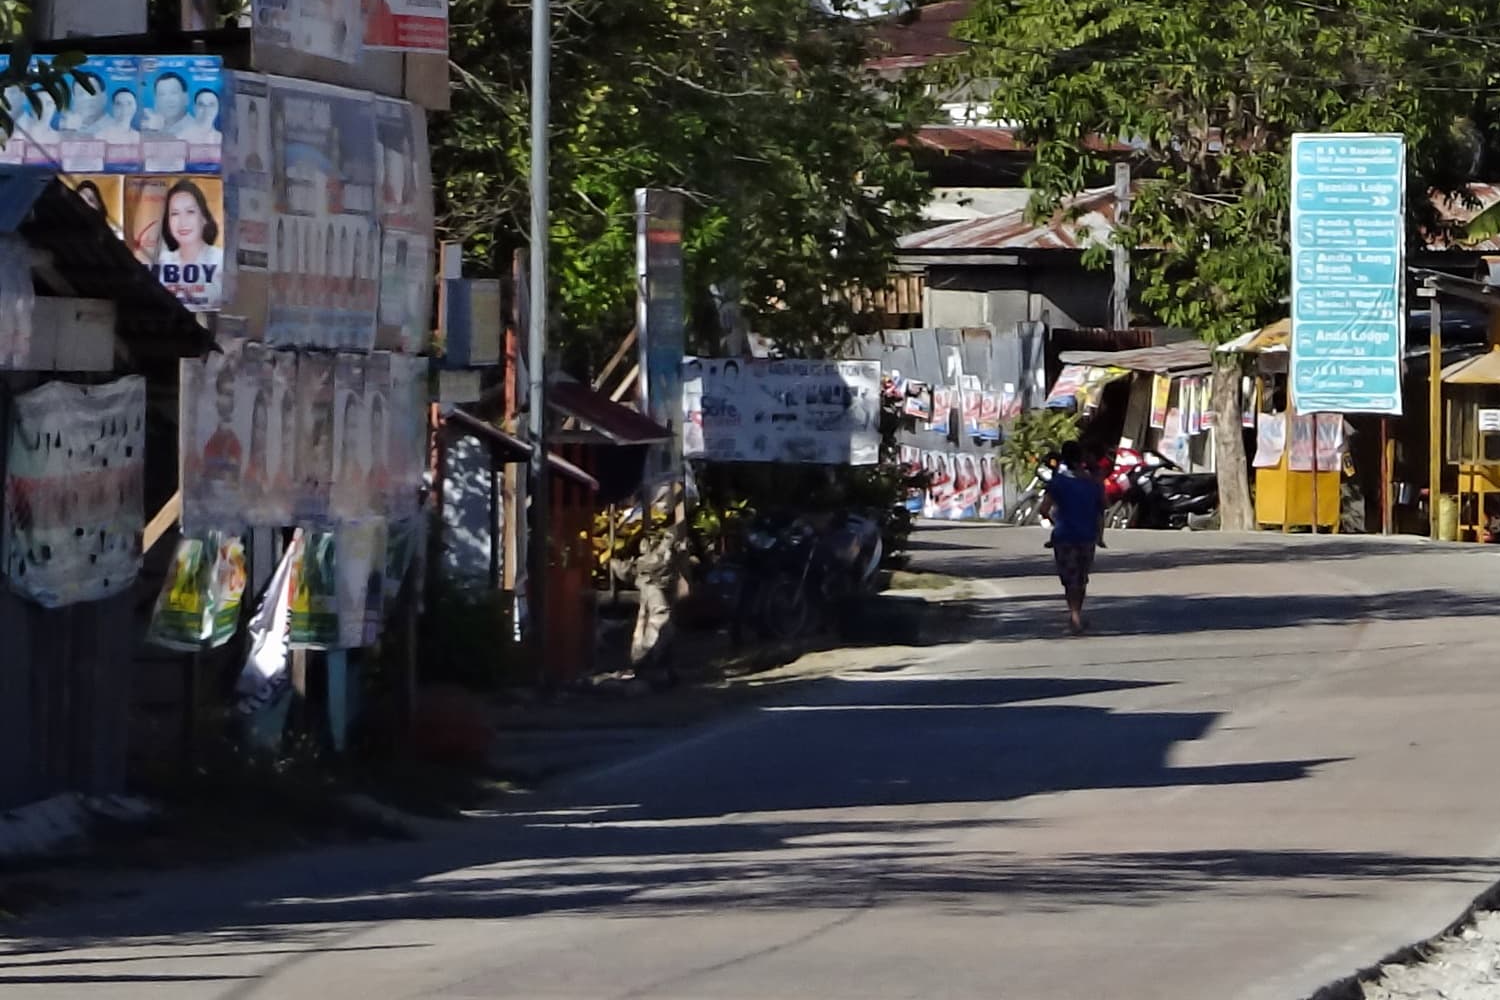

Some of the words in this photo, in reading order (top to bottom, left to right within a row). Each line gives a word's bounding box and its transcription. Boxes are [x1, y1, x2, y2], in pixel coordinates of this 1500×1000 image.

[1317, 252, 1353, 263] Anda
[1356, 252, 1392, 265] Long
[1315, 263, 1352, 274] Beach
[1315, 329, 1348, 341] Anda
[1350, 329, 1391, 345] Lodge
